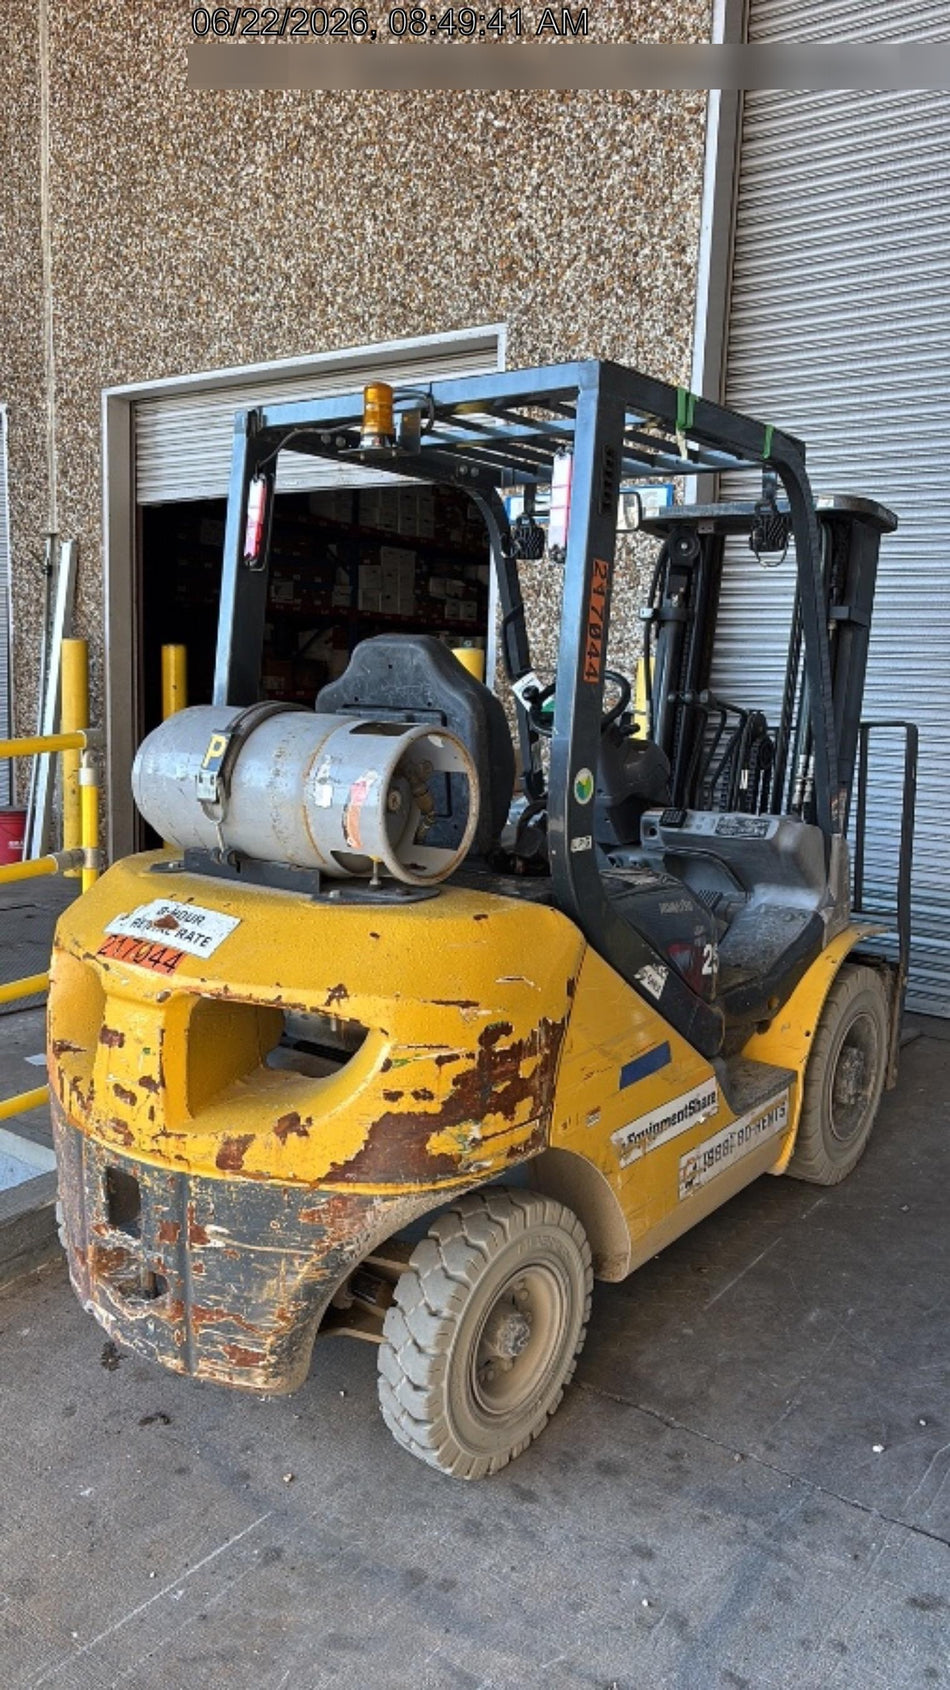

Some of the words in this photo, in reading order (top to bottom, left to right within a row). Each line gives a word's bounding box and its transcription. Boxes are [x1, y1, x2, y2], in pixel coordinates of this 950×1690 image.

[585, 561, 607, 680] 217044
[202, 735, 227, 769] P
[97, 934, 184, 973] 217044
[174, 929, 213, 948] RATE
